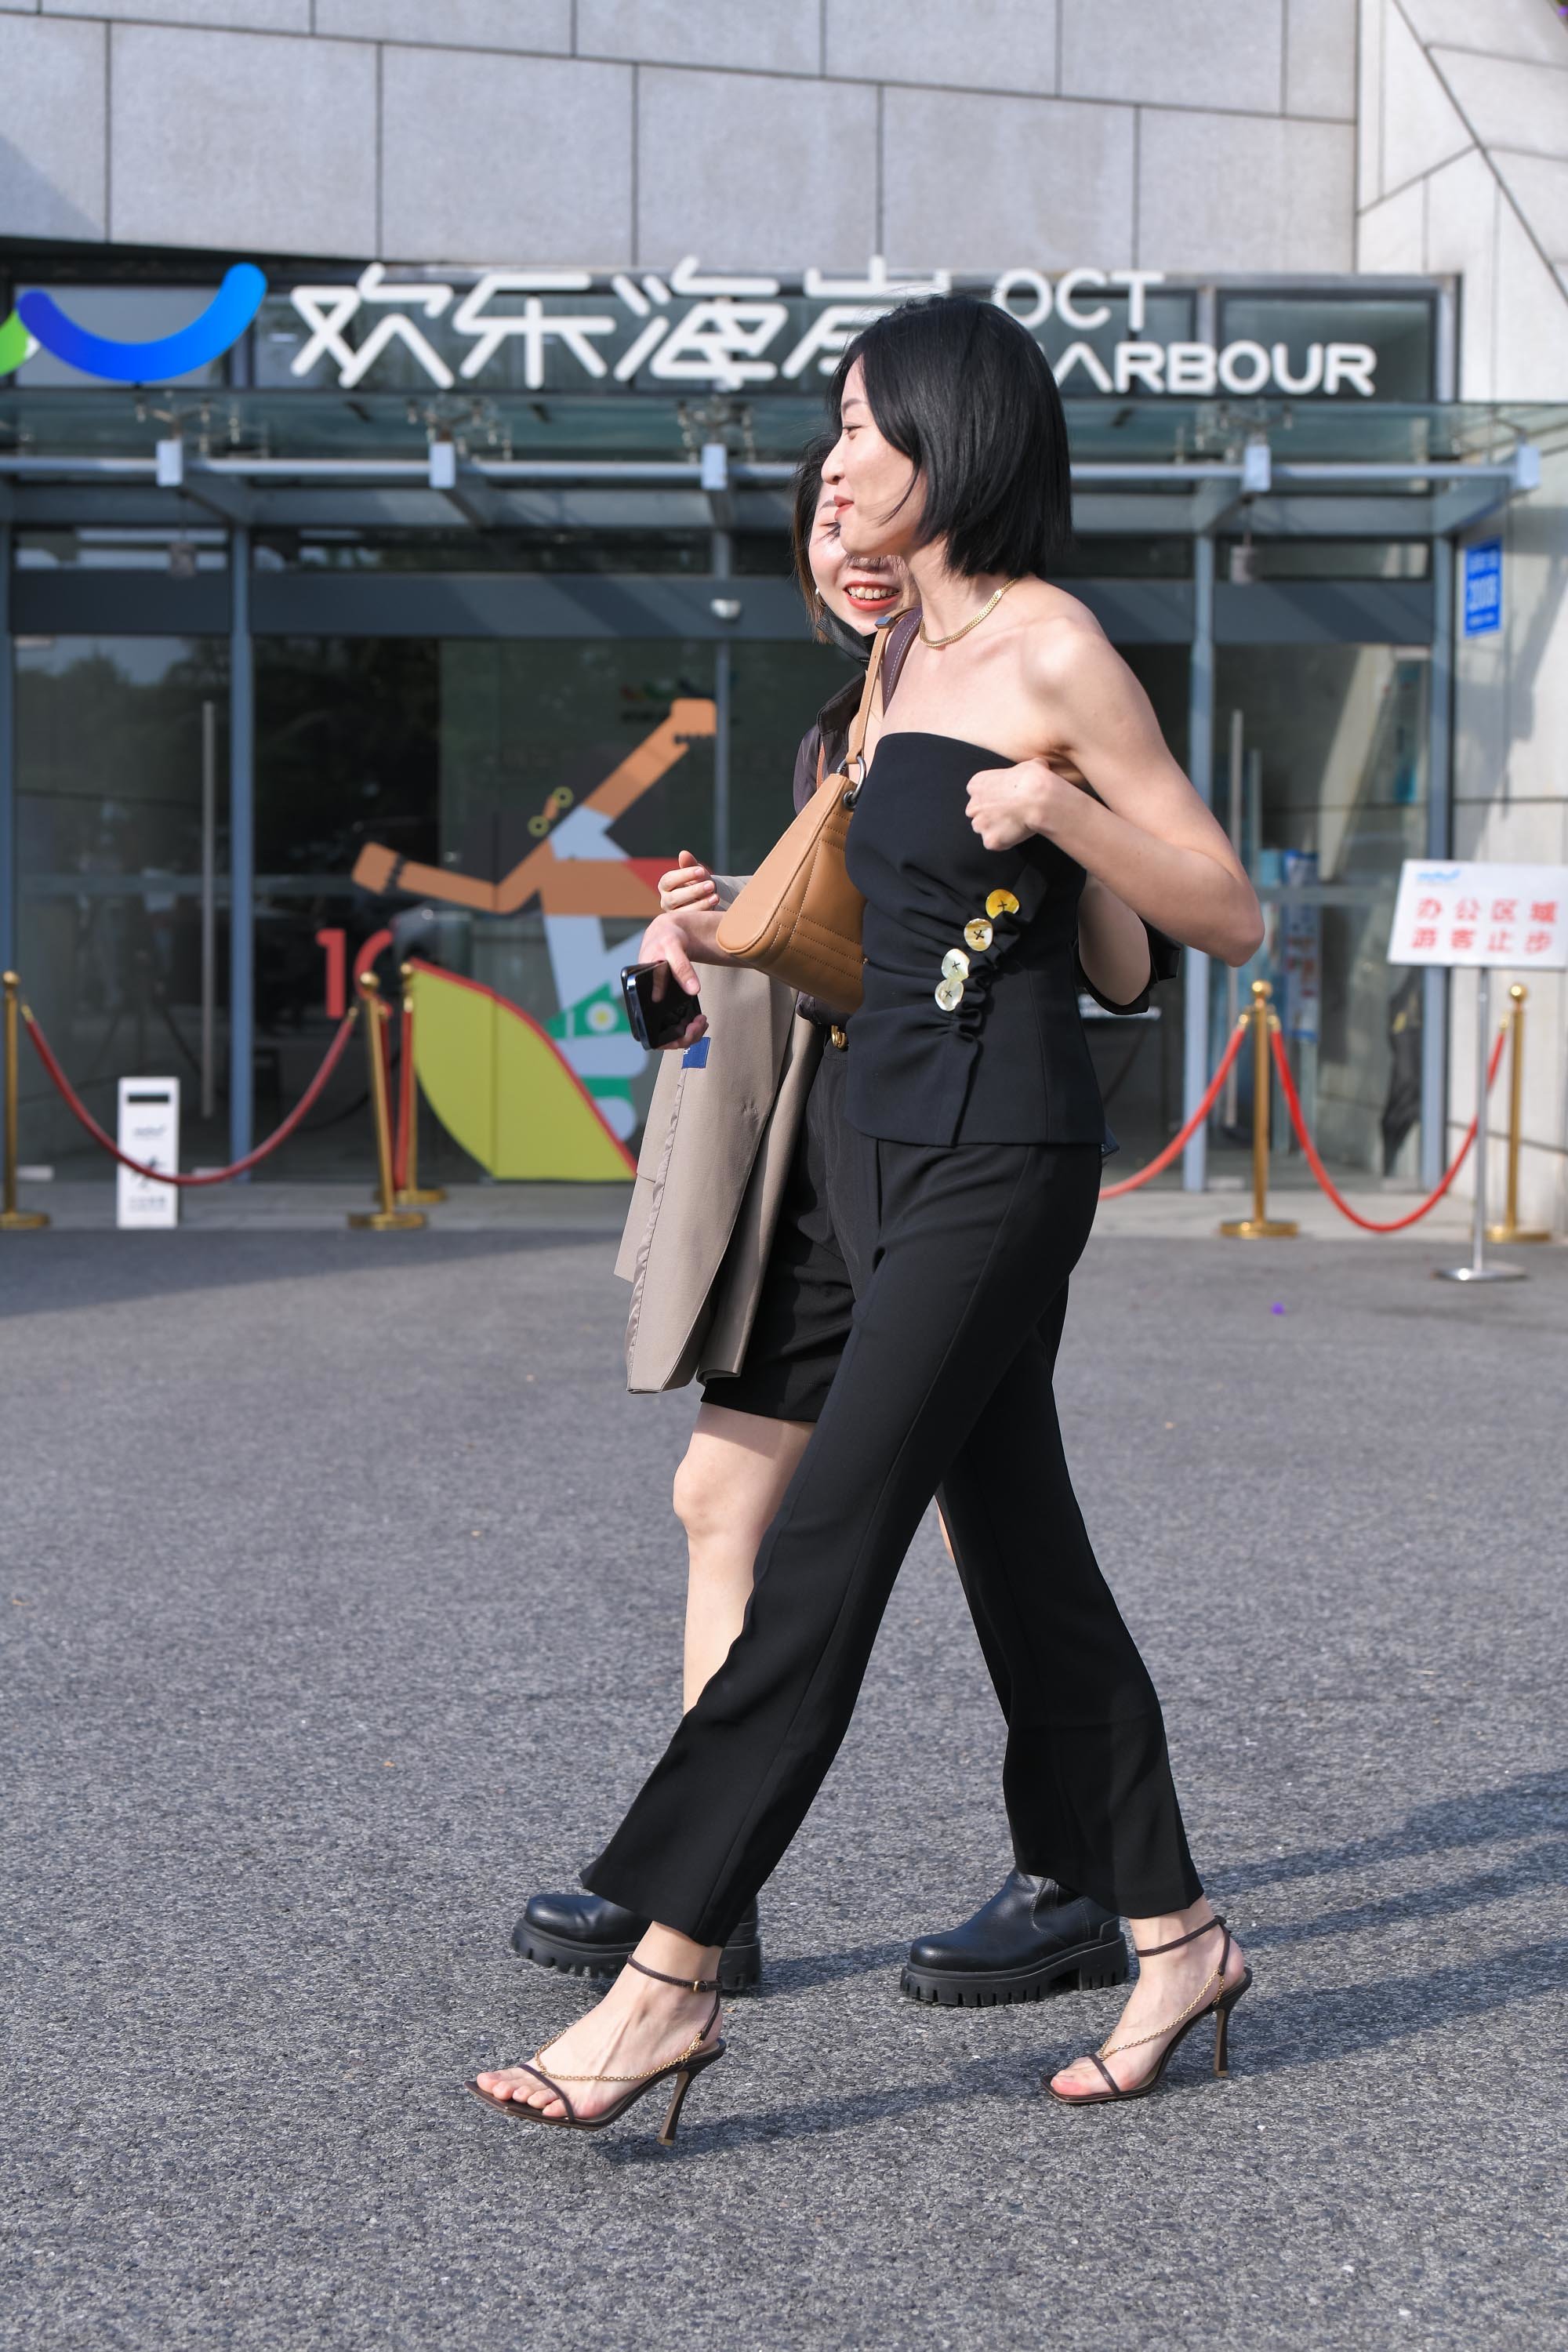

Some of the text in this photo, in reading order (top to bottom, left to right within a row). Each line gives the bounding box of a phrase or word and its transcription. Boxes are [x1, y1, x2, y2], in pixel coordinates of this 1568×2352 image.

[992, 268, 1165, 332] OCT
[1036, 339, 1377, 396] ARBOUR
[1416, 897, 1559, 925] 办公区域
[1411, 927, 1553, 954] 游客止步
